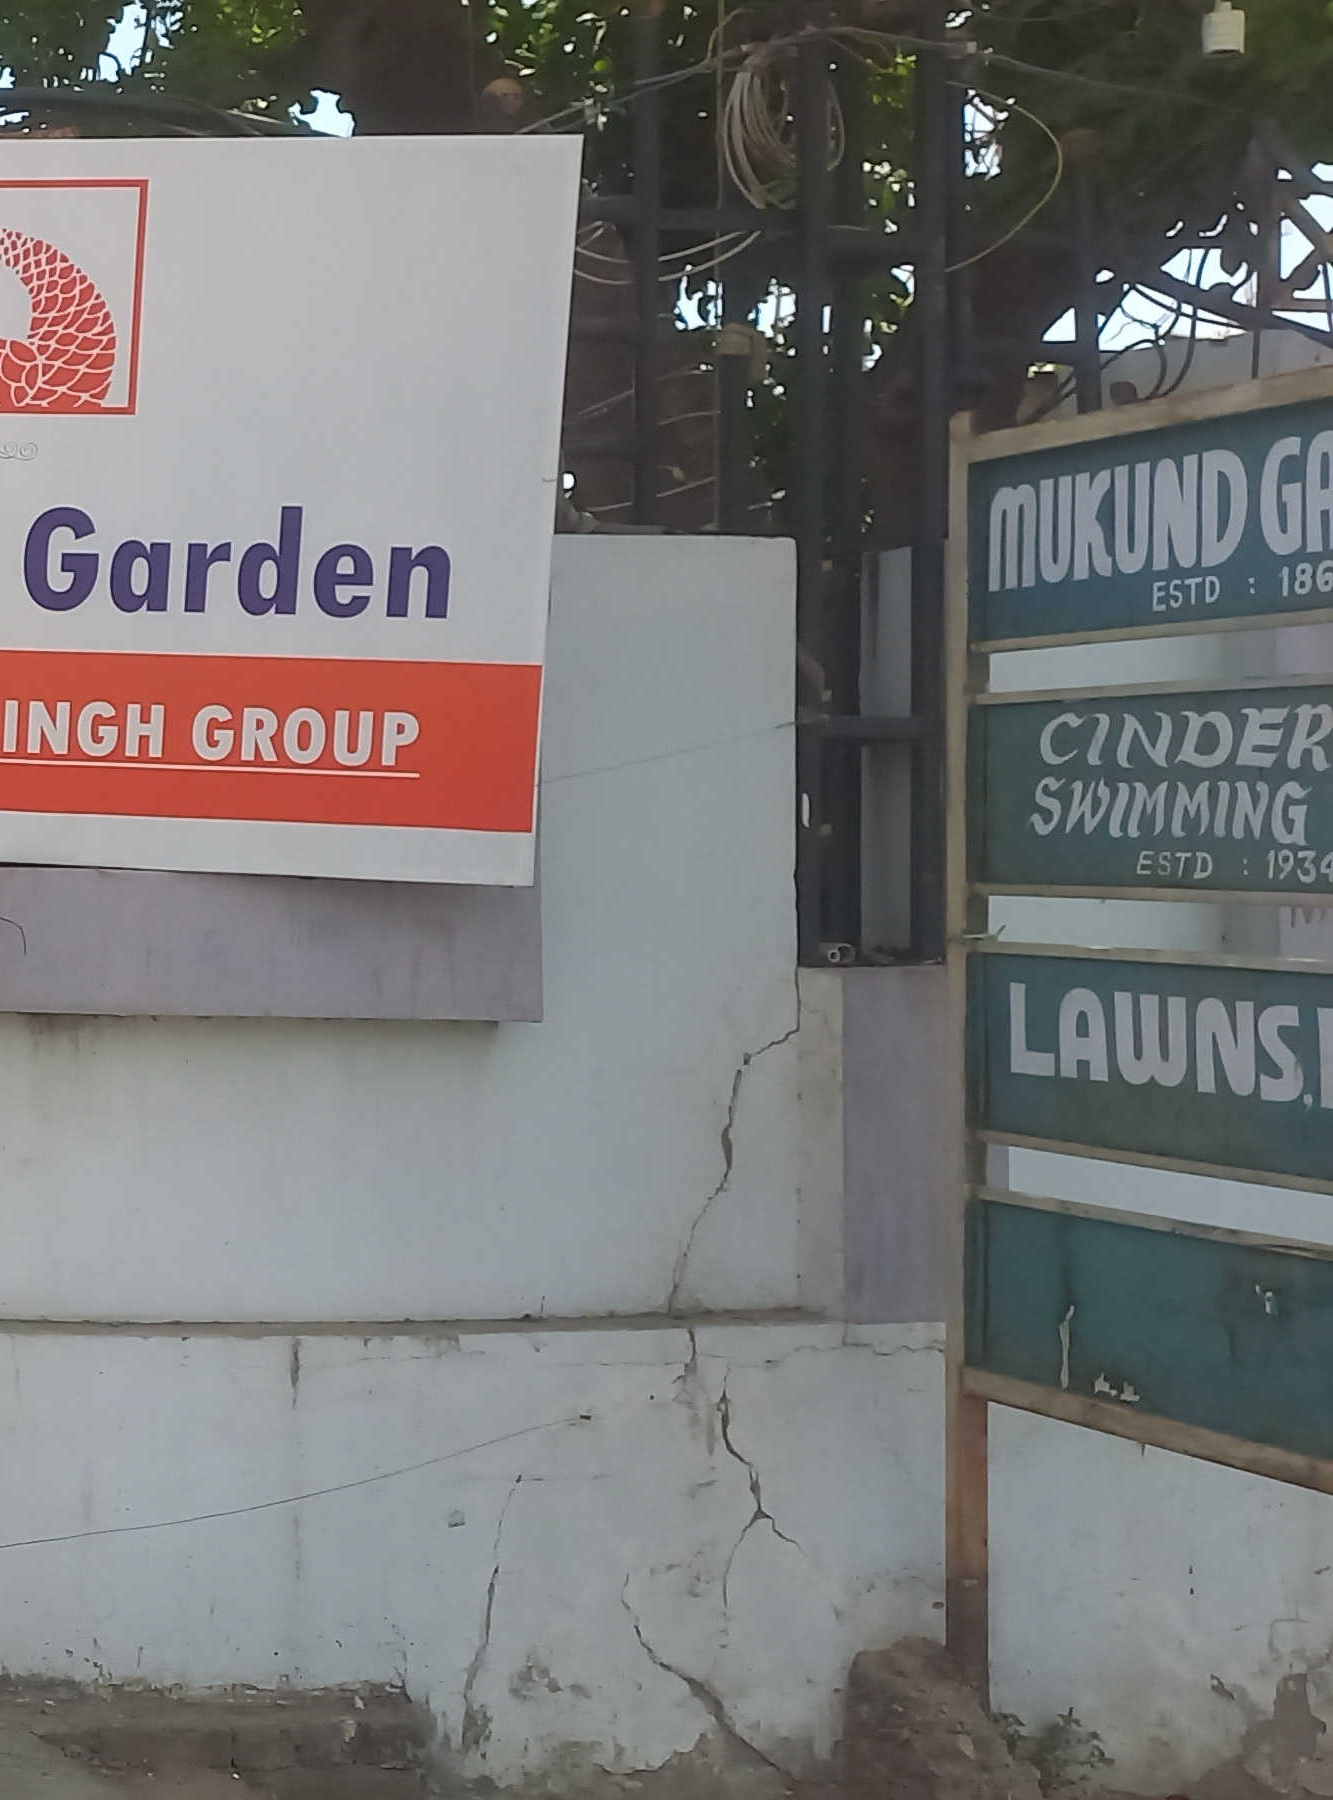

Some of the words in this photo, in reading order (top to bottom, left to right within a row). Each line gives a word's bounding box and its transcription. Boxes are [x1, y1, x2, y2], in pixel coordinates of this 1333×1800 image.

[988, 449, 1248, 592] MUKUND
[23, 505, 452, 620] Garden
[1151, 576, 1221, 613] ESTD
[191, 706, 420, 768] GROUP
[1040, 704, 1333, 771] CINDER
[1030, 777, 1313, 846] SWIMMING
[1136, 851, 1214, 878] ESTD
[1265, 849, 1333, 884] 1934
